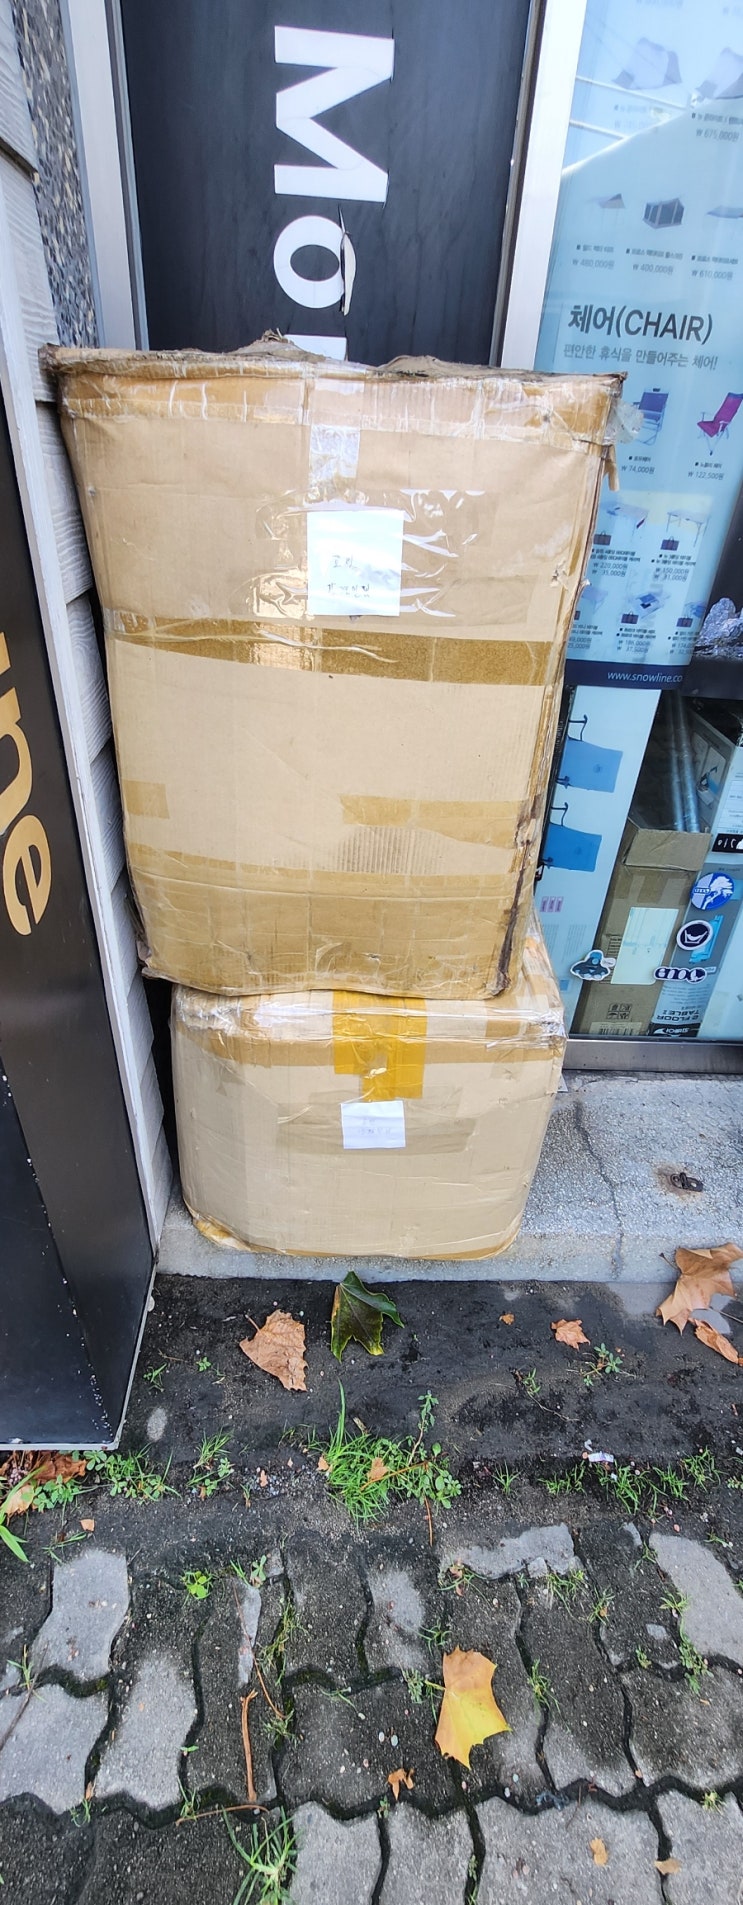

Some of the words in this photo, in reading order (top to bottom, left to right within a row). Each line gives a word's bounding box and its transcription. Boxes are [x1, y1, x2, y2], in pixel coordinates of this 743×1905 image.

[273, 25, 395, 361] Mo
[567, 304, 713, 345] 체어(CHAIR)
[563, 344, 596, 360] 편안한
[598, 345, 633, 362] 휴식을
[636, 349, 689, 368] 만들어주는
[691, 354, 719, 371] 체어!
[656, 1014, 691, 1022] FLOOR
